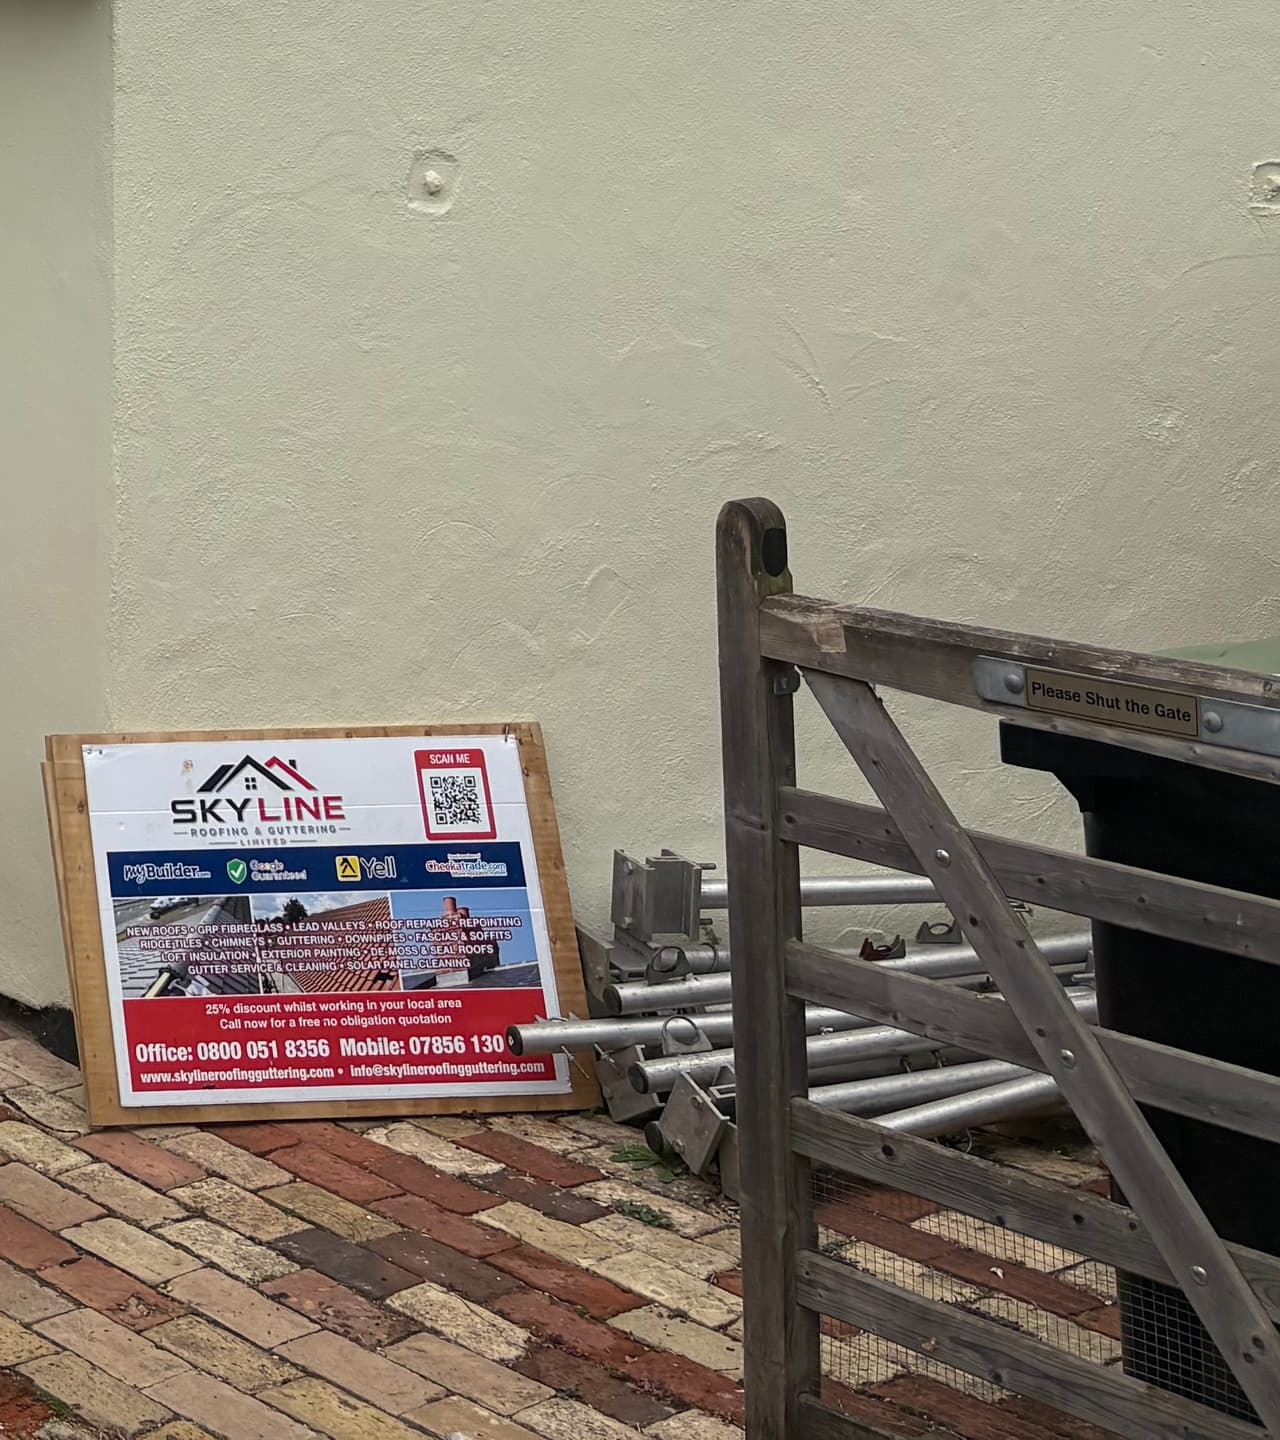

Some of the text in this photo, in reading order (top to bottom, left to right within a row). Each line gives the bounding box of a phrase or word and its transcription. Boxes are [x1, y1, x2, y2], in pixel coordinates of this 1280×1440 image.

[1031, 680, 1192, 723] Please Shut the Gate
[430, 753, 470, 764] SCAN ME
[172, 797, 346, 824] SKYLINE
[189, 824, 338, 839] ROOFING & GUTTERING
[240, 838, 287, 847] LIMITED
[249, 859, 285, 872] Google
[360, 856, 397, 878] Yell
[425, 859, 508, 873] Checkatrade.com
[251, 869, 307, 881] Guaranteed
[127, 917, 522, 937] NEW ROOFS GRP FIBREGLASS LEAD VALLEYS ROOF REPAIRS REPOINTING
[140, 930, 512, 950] RIDGE TILES CHIMNEYS GUTTERING DOWNPIPES FASCIAS & SOFFITS
[161, 943, 494, 962] LOFT INSULATION EXTERIOR PAINTING DE-MOSS & SEAL ROOFS
[187, 958, 471, 975] GUTTER SERVICE & CLEANING SOLAR PANEL CLEANING
[205, 998, 462, 1015] 25% discount whilst working in your local area
[220, 1013, 452, 1030] Call now for a free no obligation quotation
[135, 1034, 505, 1063] Office: 0800 051 8356 Mobile: 07856 130
[140, 1061, 546, 1085] www.skylineroofingguttering.com info@skylineroofingguttering.com
